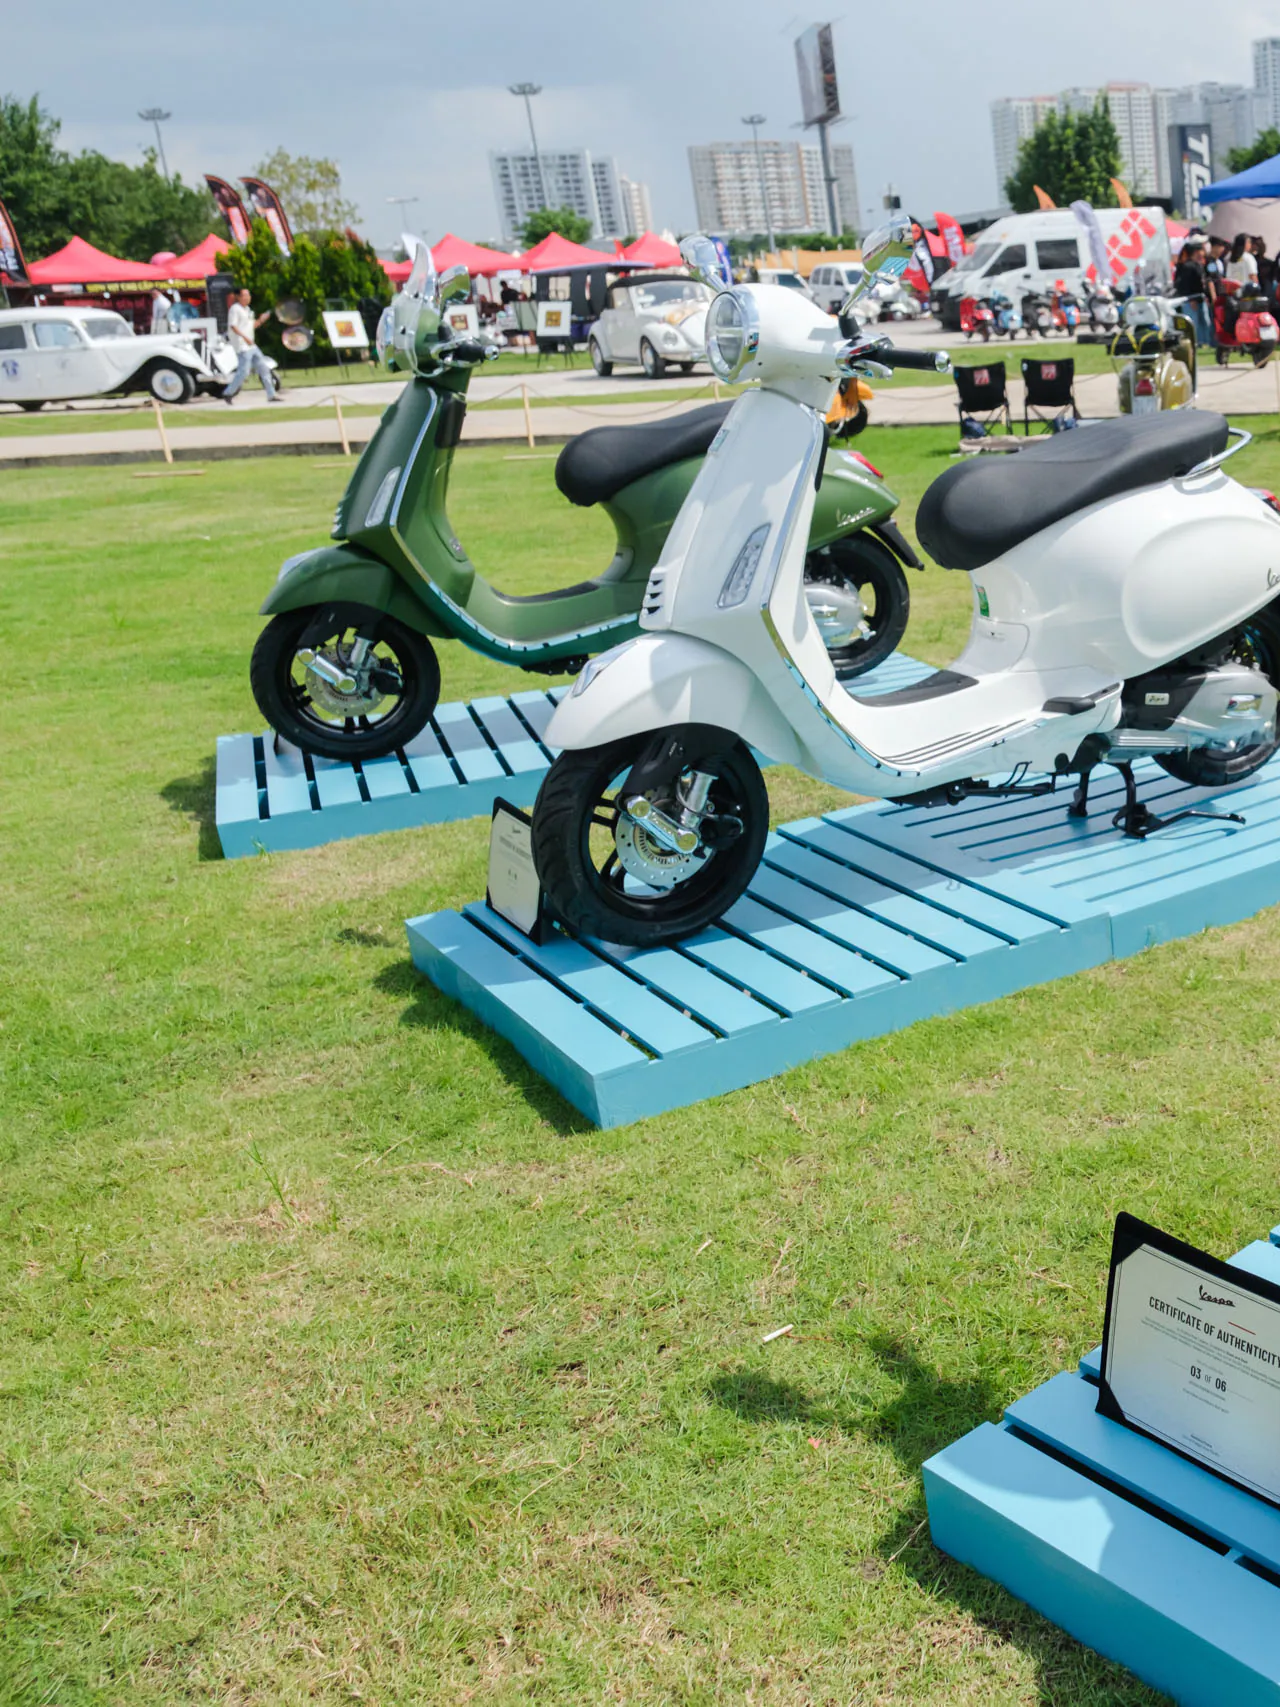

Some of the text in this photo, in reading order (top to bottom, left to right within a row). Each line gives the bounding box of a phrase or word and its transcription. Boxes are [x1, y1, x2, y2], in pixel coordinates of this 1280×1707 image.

[1198, 1284, 1236, 1308] Vespa
[1149, 1296, 1202, 1331] CERTIFICATE
[1203, 1322, 1216, 1336] OF
[1190, 1365, 1202, 1380] 03
[1215, 1377, 1227, 1392] 06
